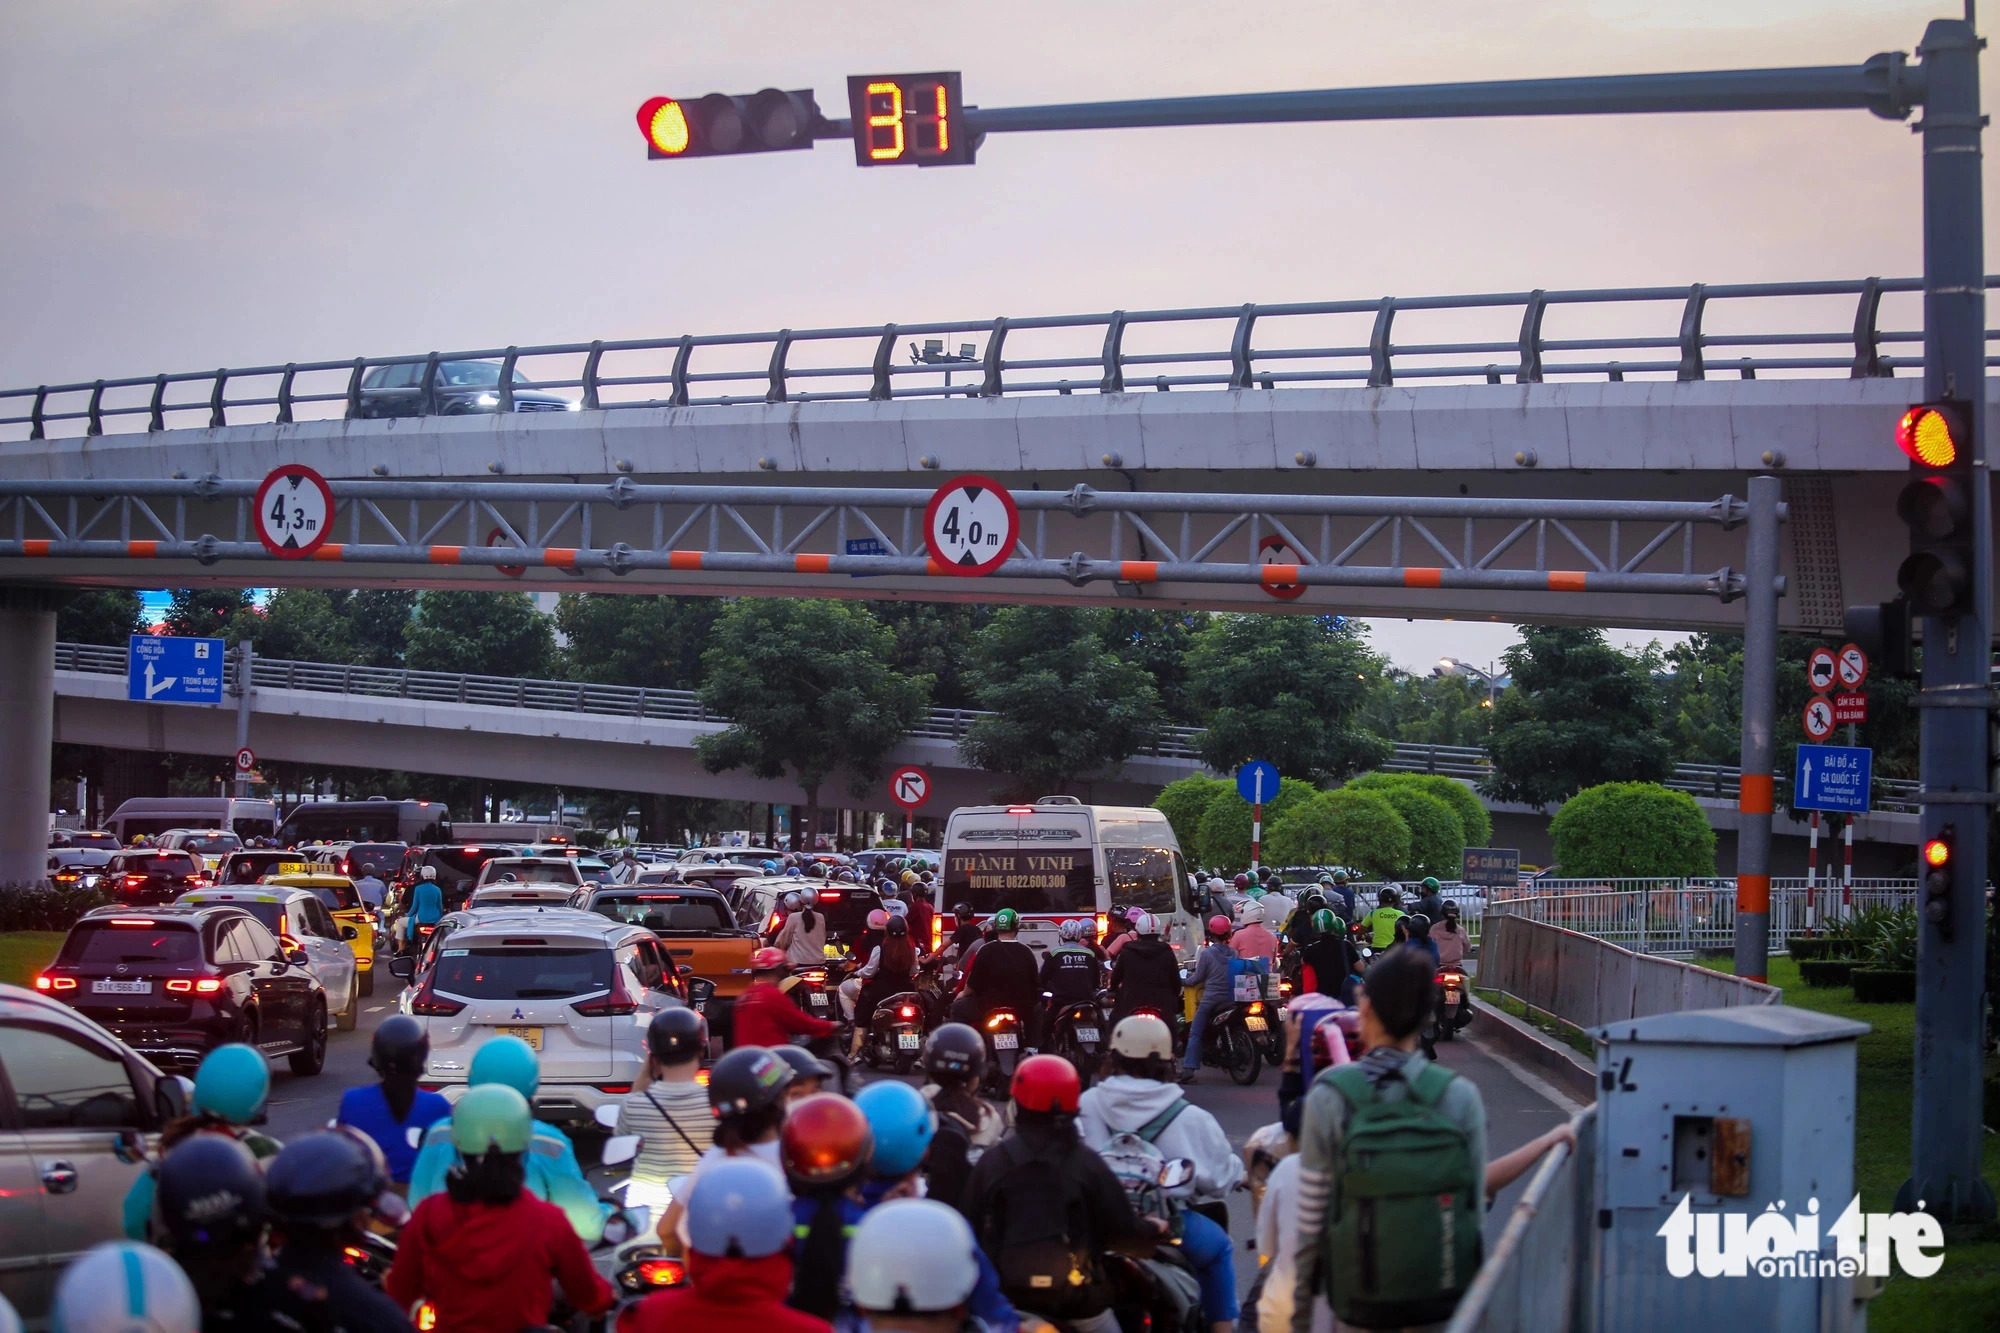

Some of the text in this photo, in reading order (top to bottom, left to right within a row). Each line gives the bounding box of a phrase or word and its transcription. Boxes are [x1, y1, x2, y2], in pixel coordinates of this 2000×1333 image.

[866, 81, 949, 160] 31
[197, 667, 206, 676] GA
[182, 676, 219, 686] TRONG NƯỚC
[1838, 695, 1848, 706] CẤM
[1836, 709, 1864, 720] VÀ BA BÁNH
[1824, 754, 1836, 768] BÃI
[1820, 770, 1862, 786] GA QUỐC TẾ
[1824, 786, 1855, 795] International
[951, 853, 1074, 871] THÀNH VINH
[1480, 854, 1517, 869] CẤM XE
[970, 874, 1066, 888] HOTLINE: 0822.600.300
[508, 1028, 530, 1038] 50E
